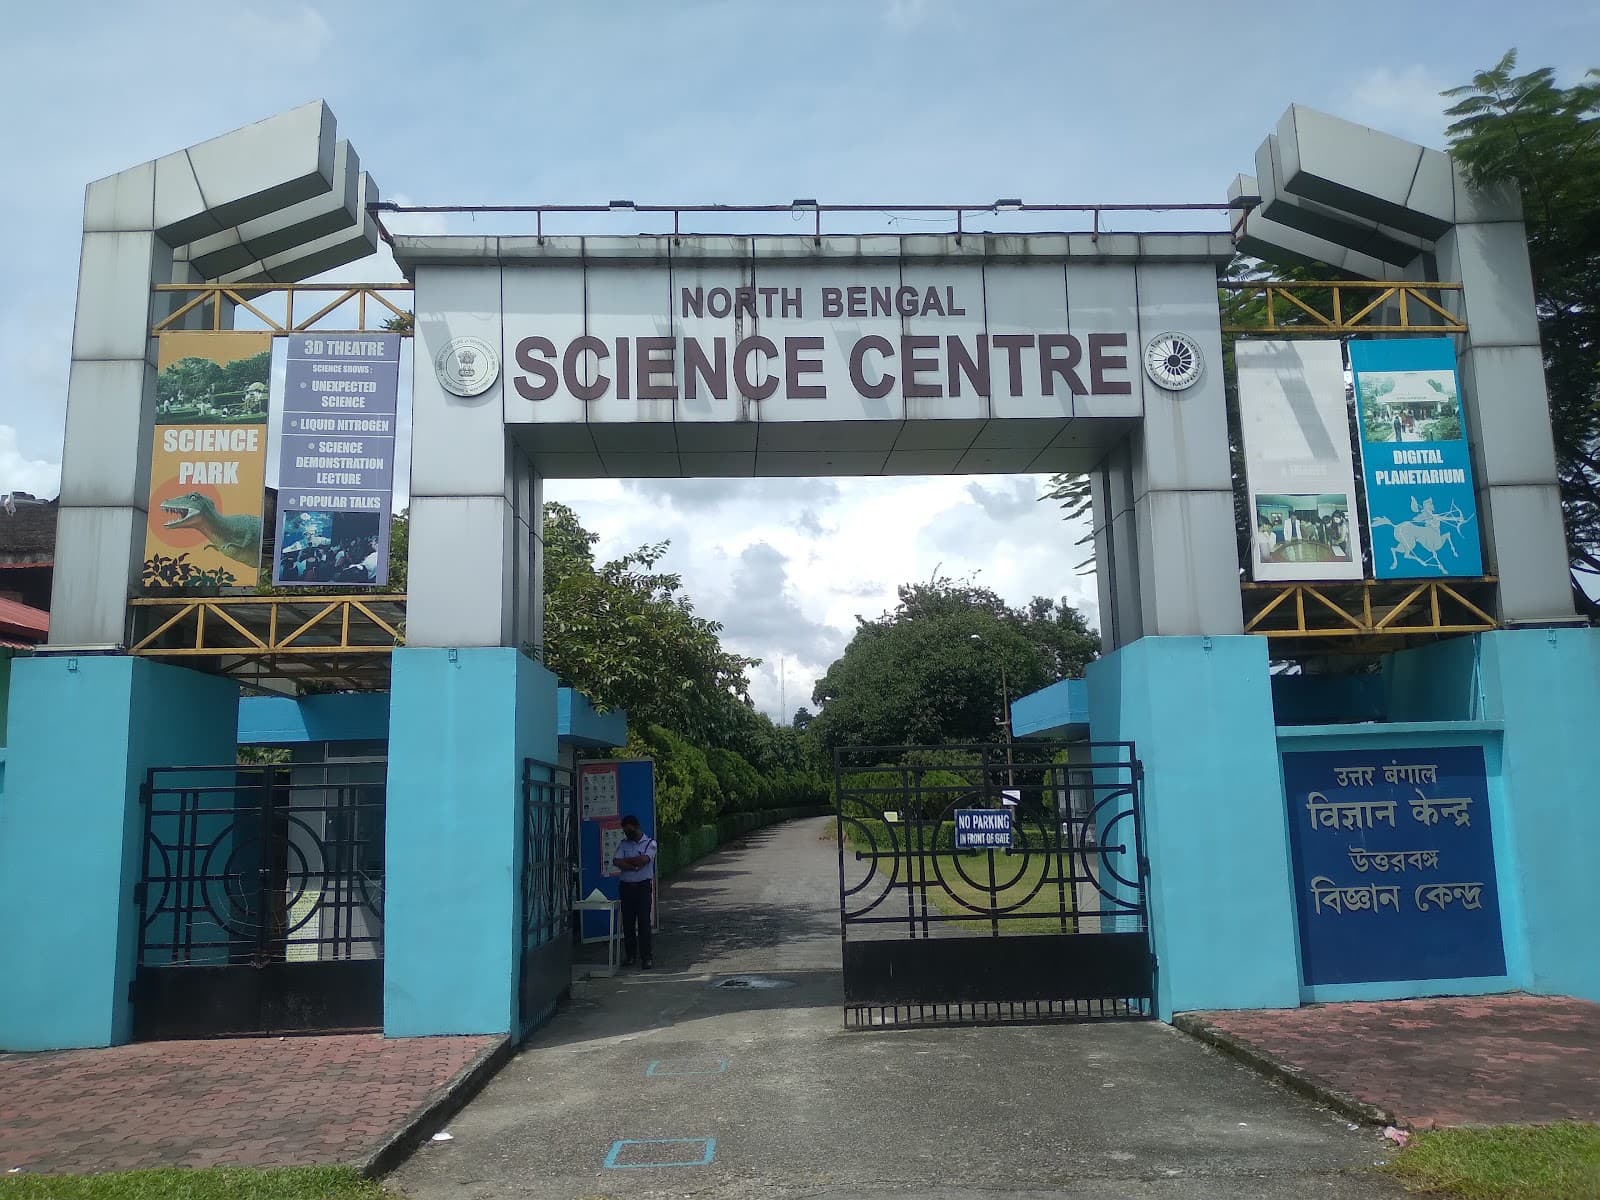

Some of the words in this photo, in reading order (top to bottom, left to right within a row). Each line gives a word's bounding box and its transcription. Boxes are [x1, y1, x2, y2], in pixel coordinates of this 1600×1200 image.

[681, 287, 803, 319] NORTH
[821, 286, 966, 318] BENGAL
[304, 340, 324, 355] 3D
[326, 341, 385, 356] THEATRE
[312, 364, 342, 373] SCIENCE
[513, 335, 827, 401] SCIENCE
[848, 333, 1132, 400] CENTRE
[311, 380, 377, 393] UNEXPECTED
[321, 395, 366, 408] SCIENCE
[300, 418, 335, 431] LIQUID
[337, 420, 389, 432] NITROGEN
[163, 429, 259, 453] SCIENCE
[318, 441, 363, 454] SCIENCE
[295, 456, 384, 470] DEMONSTRATION
[1392, 449, 1444, 465] DIGITAL
[178, 461, 240, 485] PARK
[316, 472, 362, 485] LECTURE
[1375, 468, 1465, 486] PLANETARIUM
[299, 495, 348, 508] POPULAR
[349, 496, 381, 509] TALKS
[1333, 767, 1376, 787] उत्तर
[1382, 759, 1438, 786] बंगाल
[1306, 791, 1398, 831] विज्ञान
[1407, 788, 1473, 828] केन्द्र
[958, 815, 971, 829] NO
[972, 814, 1010, 830] PARKING
[967, 832, 986, 844] FRONT
[986, 832, 995, 844] OF
[994, 832, 1010, 844] GATE
[1347, 845, 1440, 873] উত্তরবঙ্গ
[1310, 875, 1401, 916] বিজ্ঞান
[1414, 882, 1485, 912] কেন্দ্র
